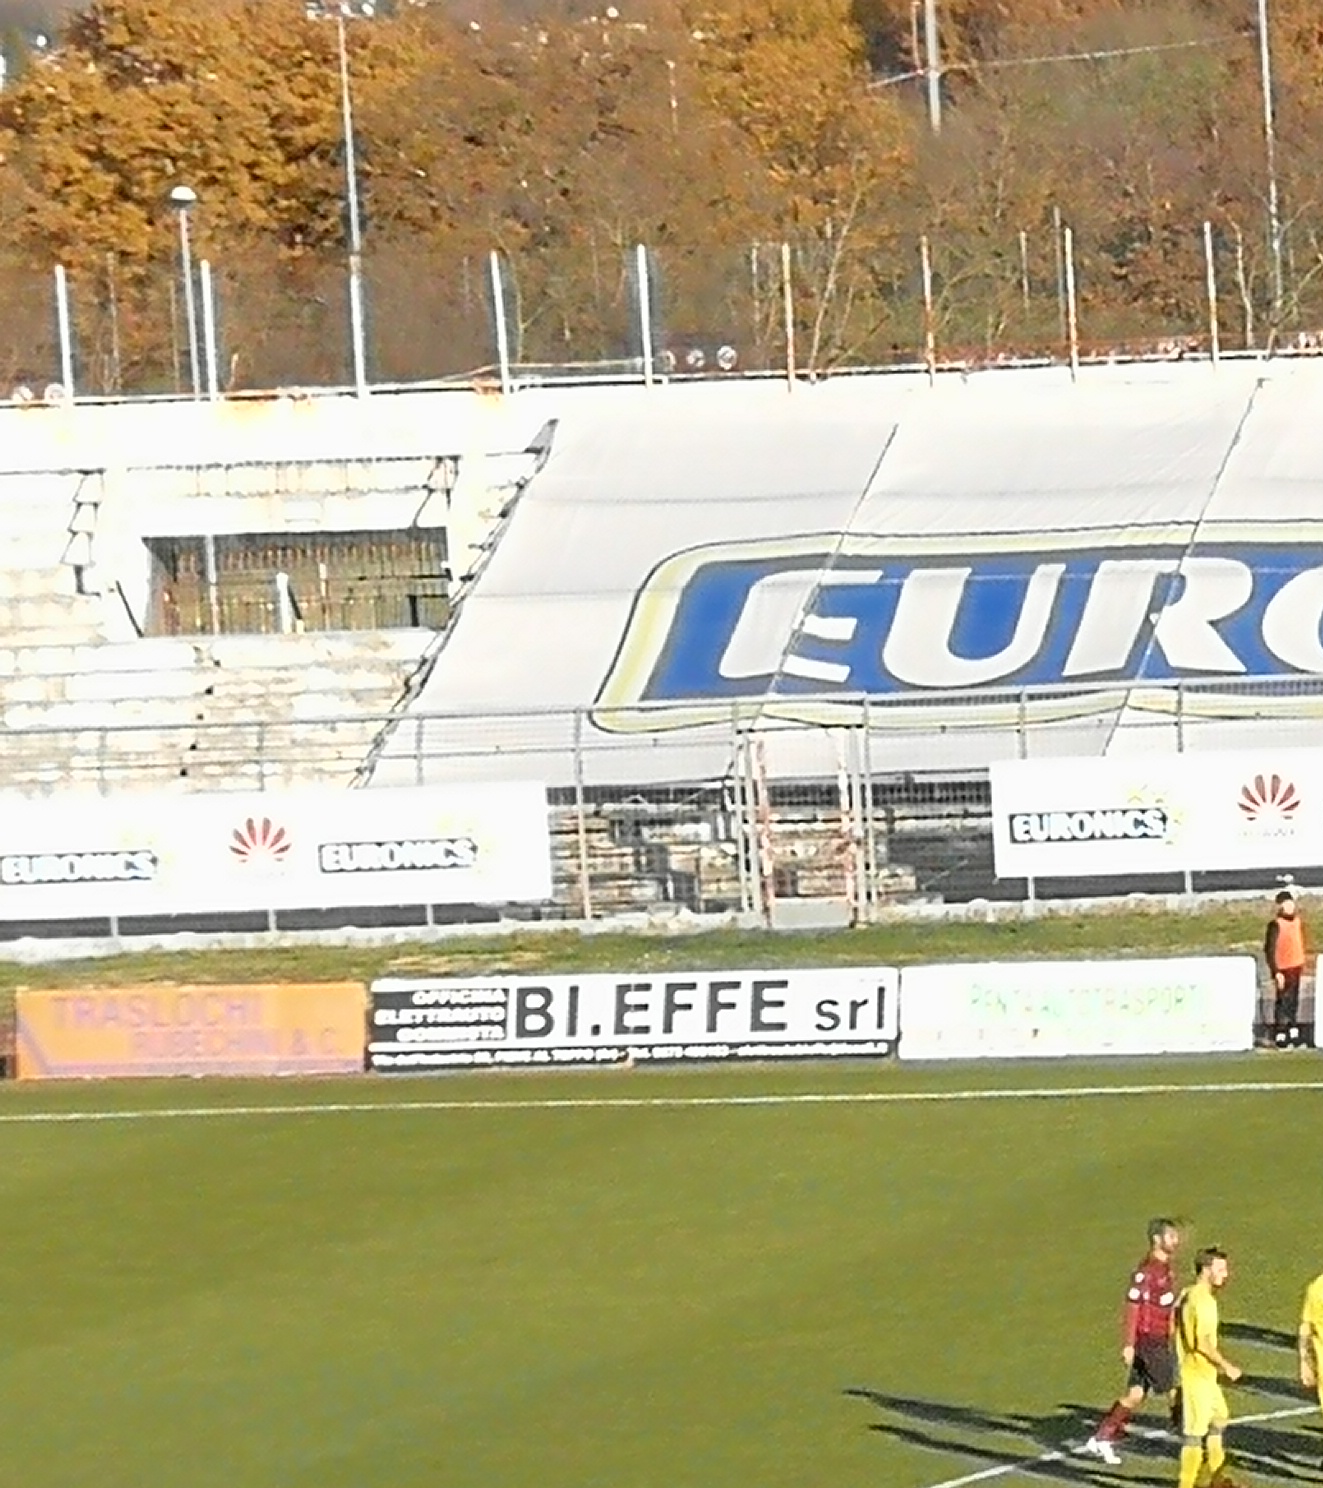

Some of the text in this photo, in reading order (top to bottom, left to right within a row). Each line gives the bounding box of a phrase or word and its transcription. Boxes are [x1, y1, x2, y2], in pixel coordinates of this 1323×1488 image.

[1011, 810, 1166, 843] EURONICS
[2, 854, 154, 884] EURONICS
[322, 841, 476, 872] EURONICS
[515, 980, 886, 1038] BI.EFFE srl
